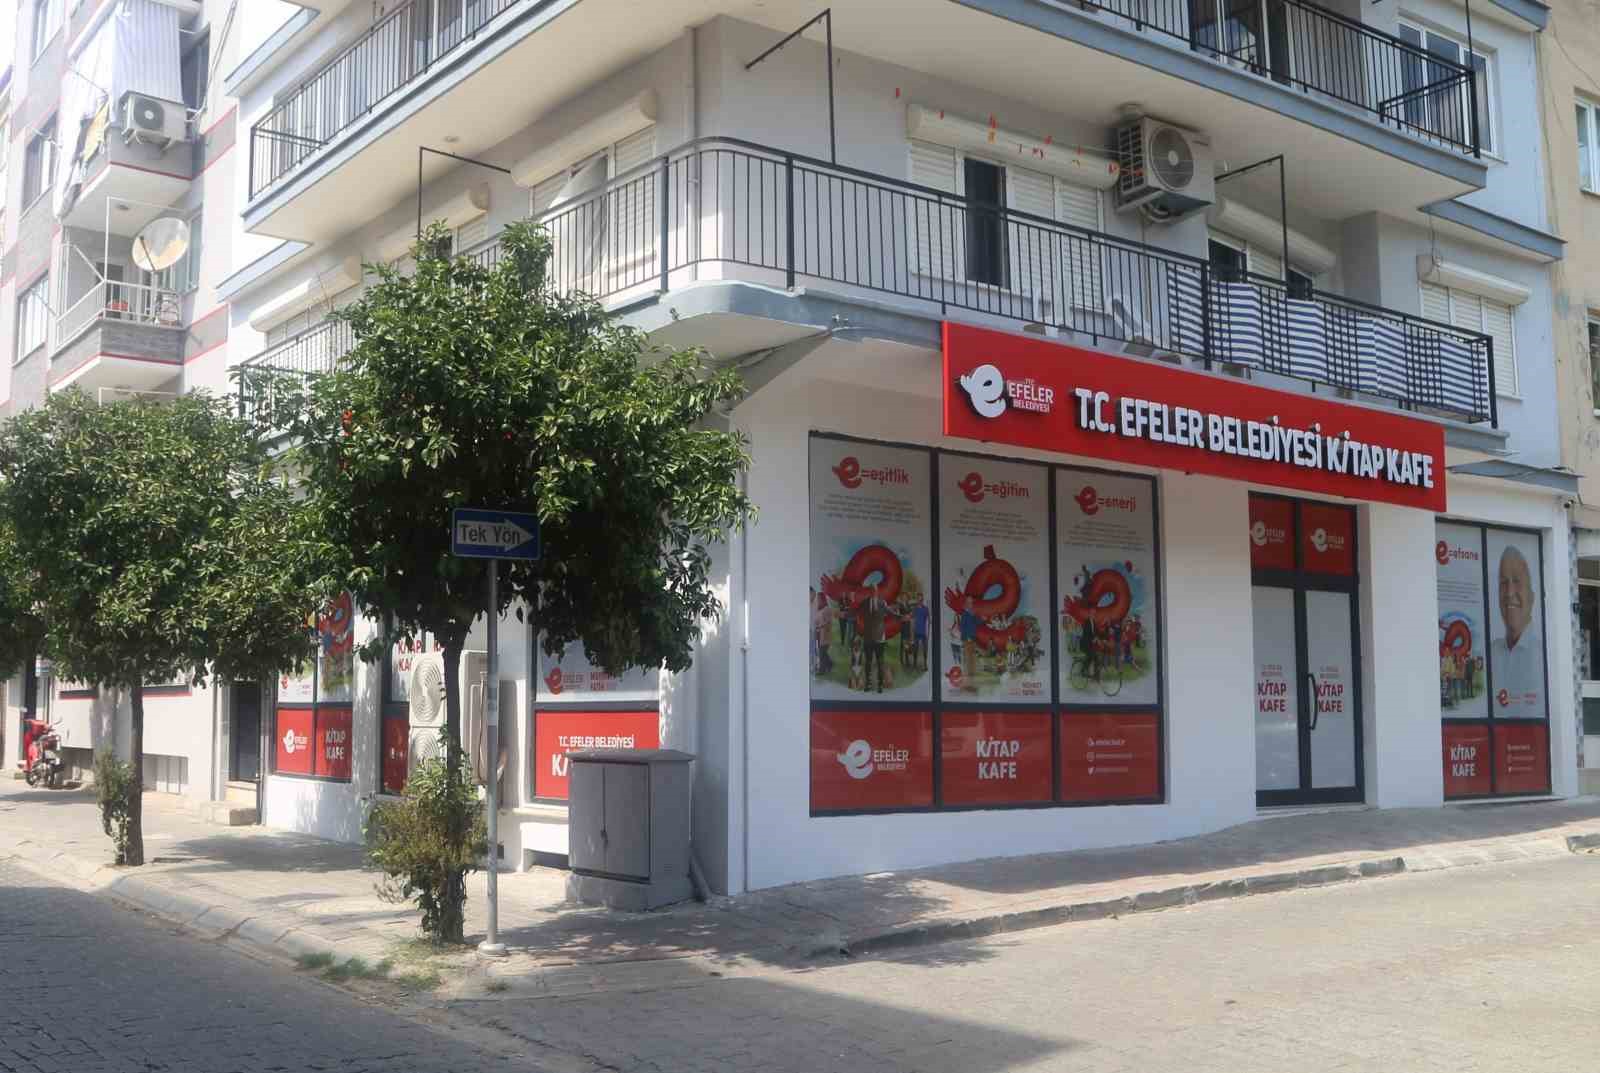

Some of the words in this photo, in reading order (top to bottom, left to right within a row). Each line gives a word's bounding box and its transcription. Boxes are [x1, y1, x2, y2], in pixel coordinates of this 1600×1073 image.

[1008, 382, 1054, 404] EFELER
[1075, 387, 1116, 434] T.C.
[1121, 397, 1204, 449] EFELER
[1208, 413, 1323, 469] BELEDİYESİ
[1327, 430, 1385, 480] KİTAP
[1386, 447, 1434, 489] KAFE
[461, 523, 488, 543] Tek
[493, 524, 521, 545] Yön
[1257, 679, 1287, 697] KİTAP
[1316, 681, 1344, 697] KİTAP
[1259, 698, 1287, 713] KAFE
[1317, 699, 1344, 713] KAFE
[570, 735, 594, 749] EFELER
[976, 736, 1020, 758] KİTAP
[873, 749, 909, 762] EFELER
[1450, 743, 1476, 761] KİTAP
[978, 762, 1018, 780] KAFE
[1452, 763, 1477, 777] KAFE
